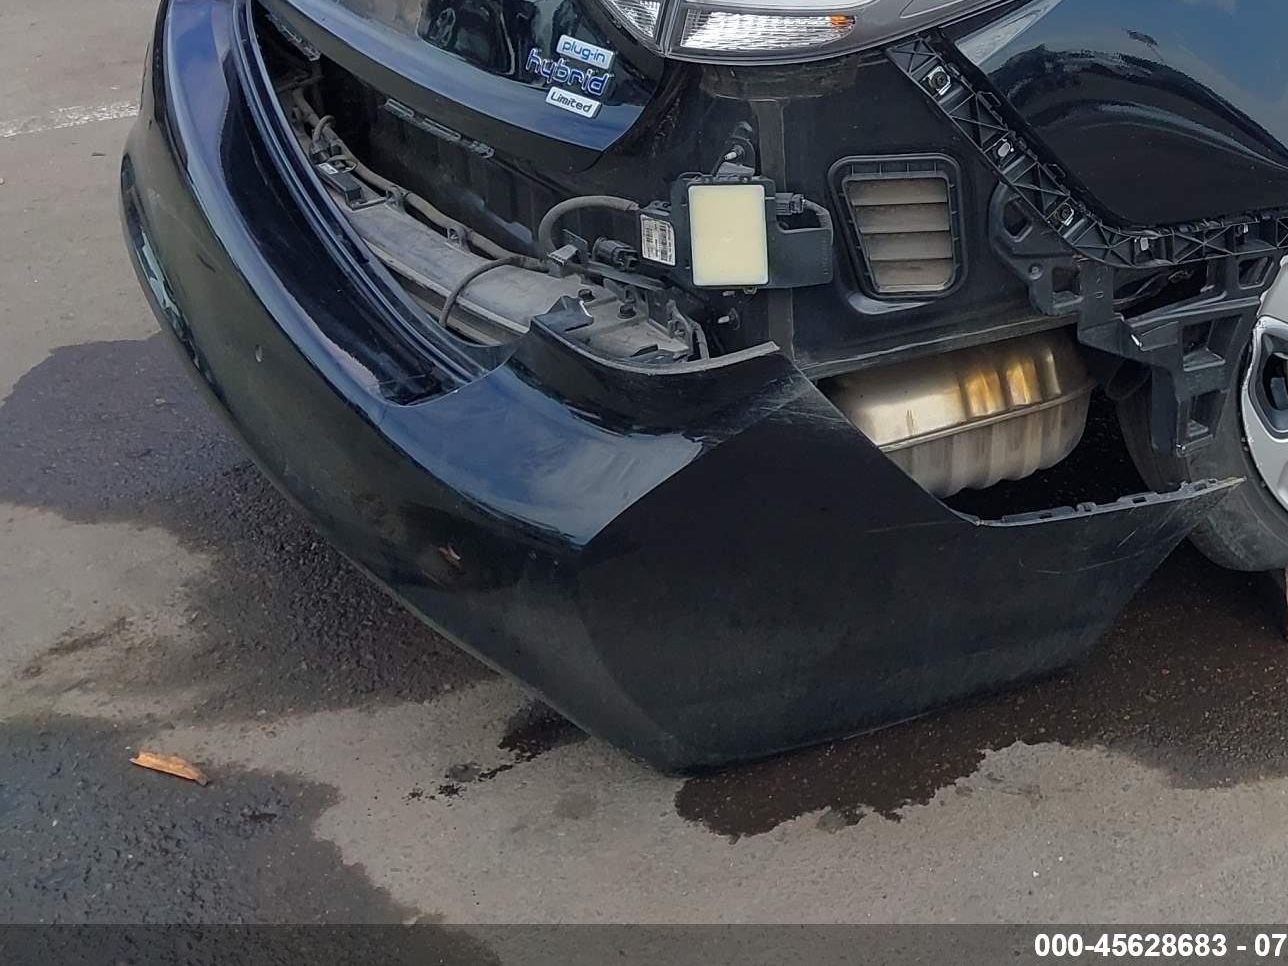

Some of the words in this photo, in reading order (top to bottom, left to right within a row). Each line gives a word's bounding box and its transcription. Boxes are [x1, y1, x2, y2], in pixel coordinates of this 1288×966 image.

[561, 39, 607, 63] plug-in
[525, 48, 610, 96] hybrid
[550, 90, 593, 113] Limited
